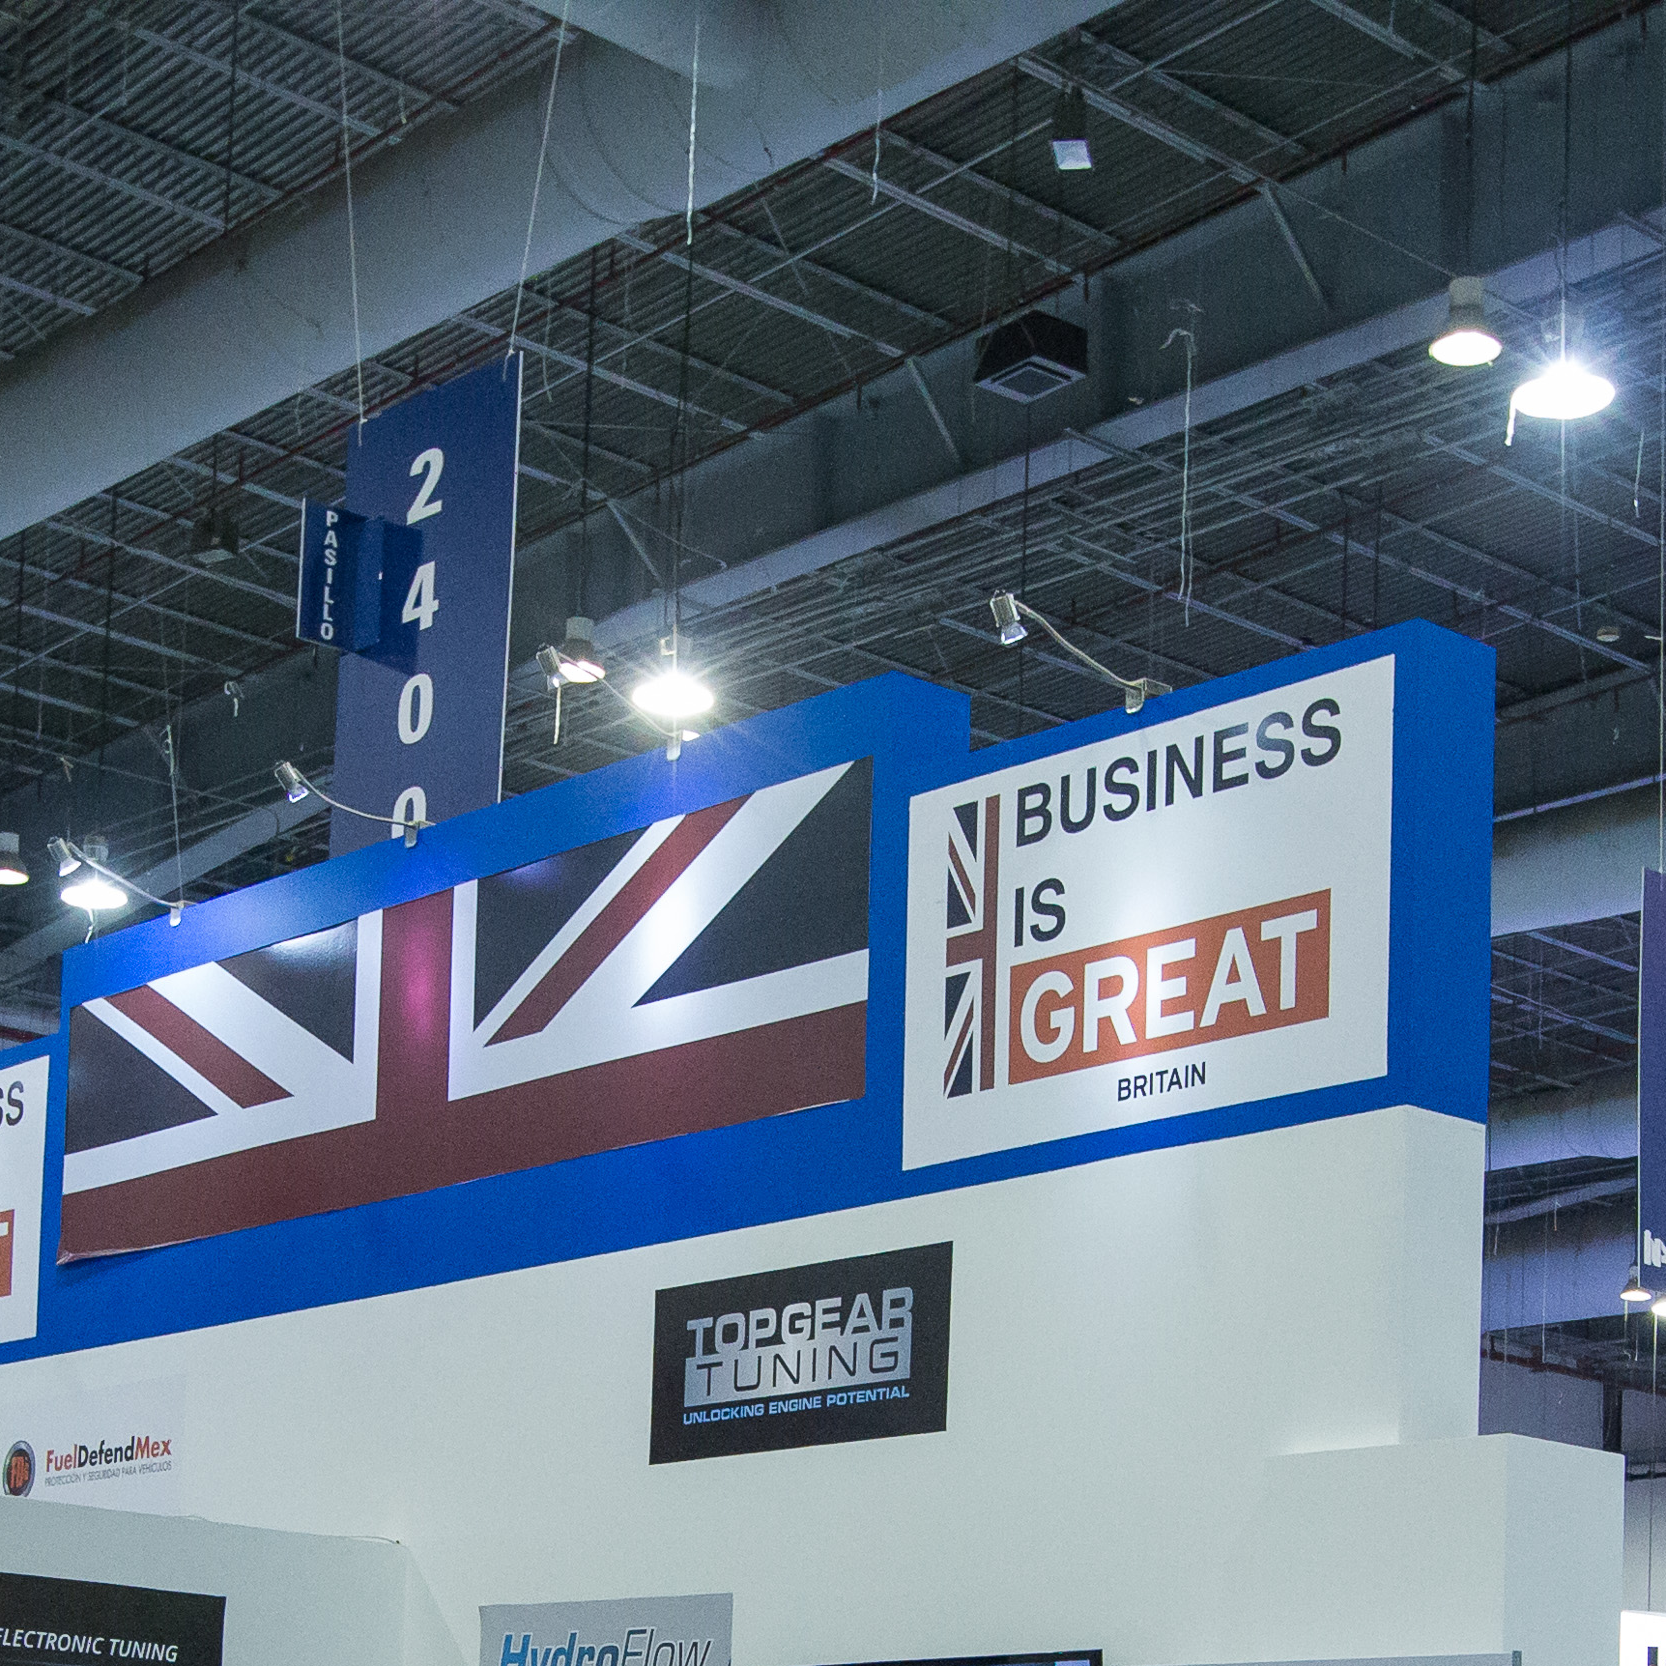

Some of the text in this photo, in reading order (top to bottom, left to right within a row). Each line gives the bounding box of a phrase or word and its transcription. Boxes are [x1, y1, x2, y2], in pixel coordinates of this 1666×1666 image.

[319, 510, 338, 641] PASILLO
[1016, 697, 1341, 847] BUSINESS
[1014, 878, 1066, 948] IS
[1020, 909, 1318, 1063] GREAT
[1117, 1062, 1206, 1102] BRITAIN
[687, 1286, 914, 1358] TOPGEAR
[697, 1337, 899, 1397] TUNING
[683, 1386, 910, 1425] UNLOCKING ENGINE POTENTIAL
[46, 1435, 172, 1473] FuelDefendMex
[109, 1638, 178, 1663] TUNING
